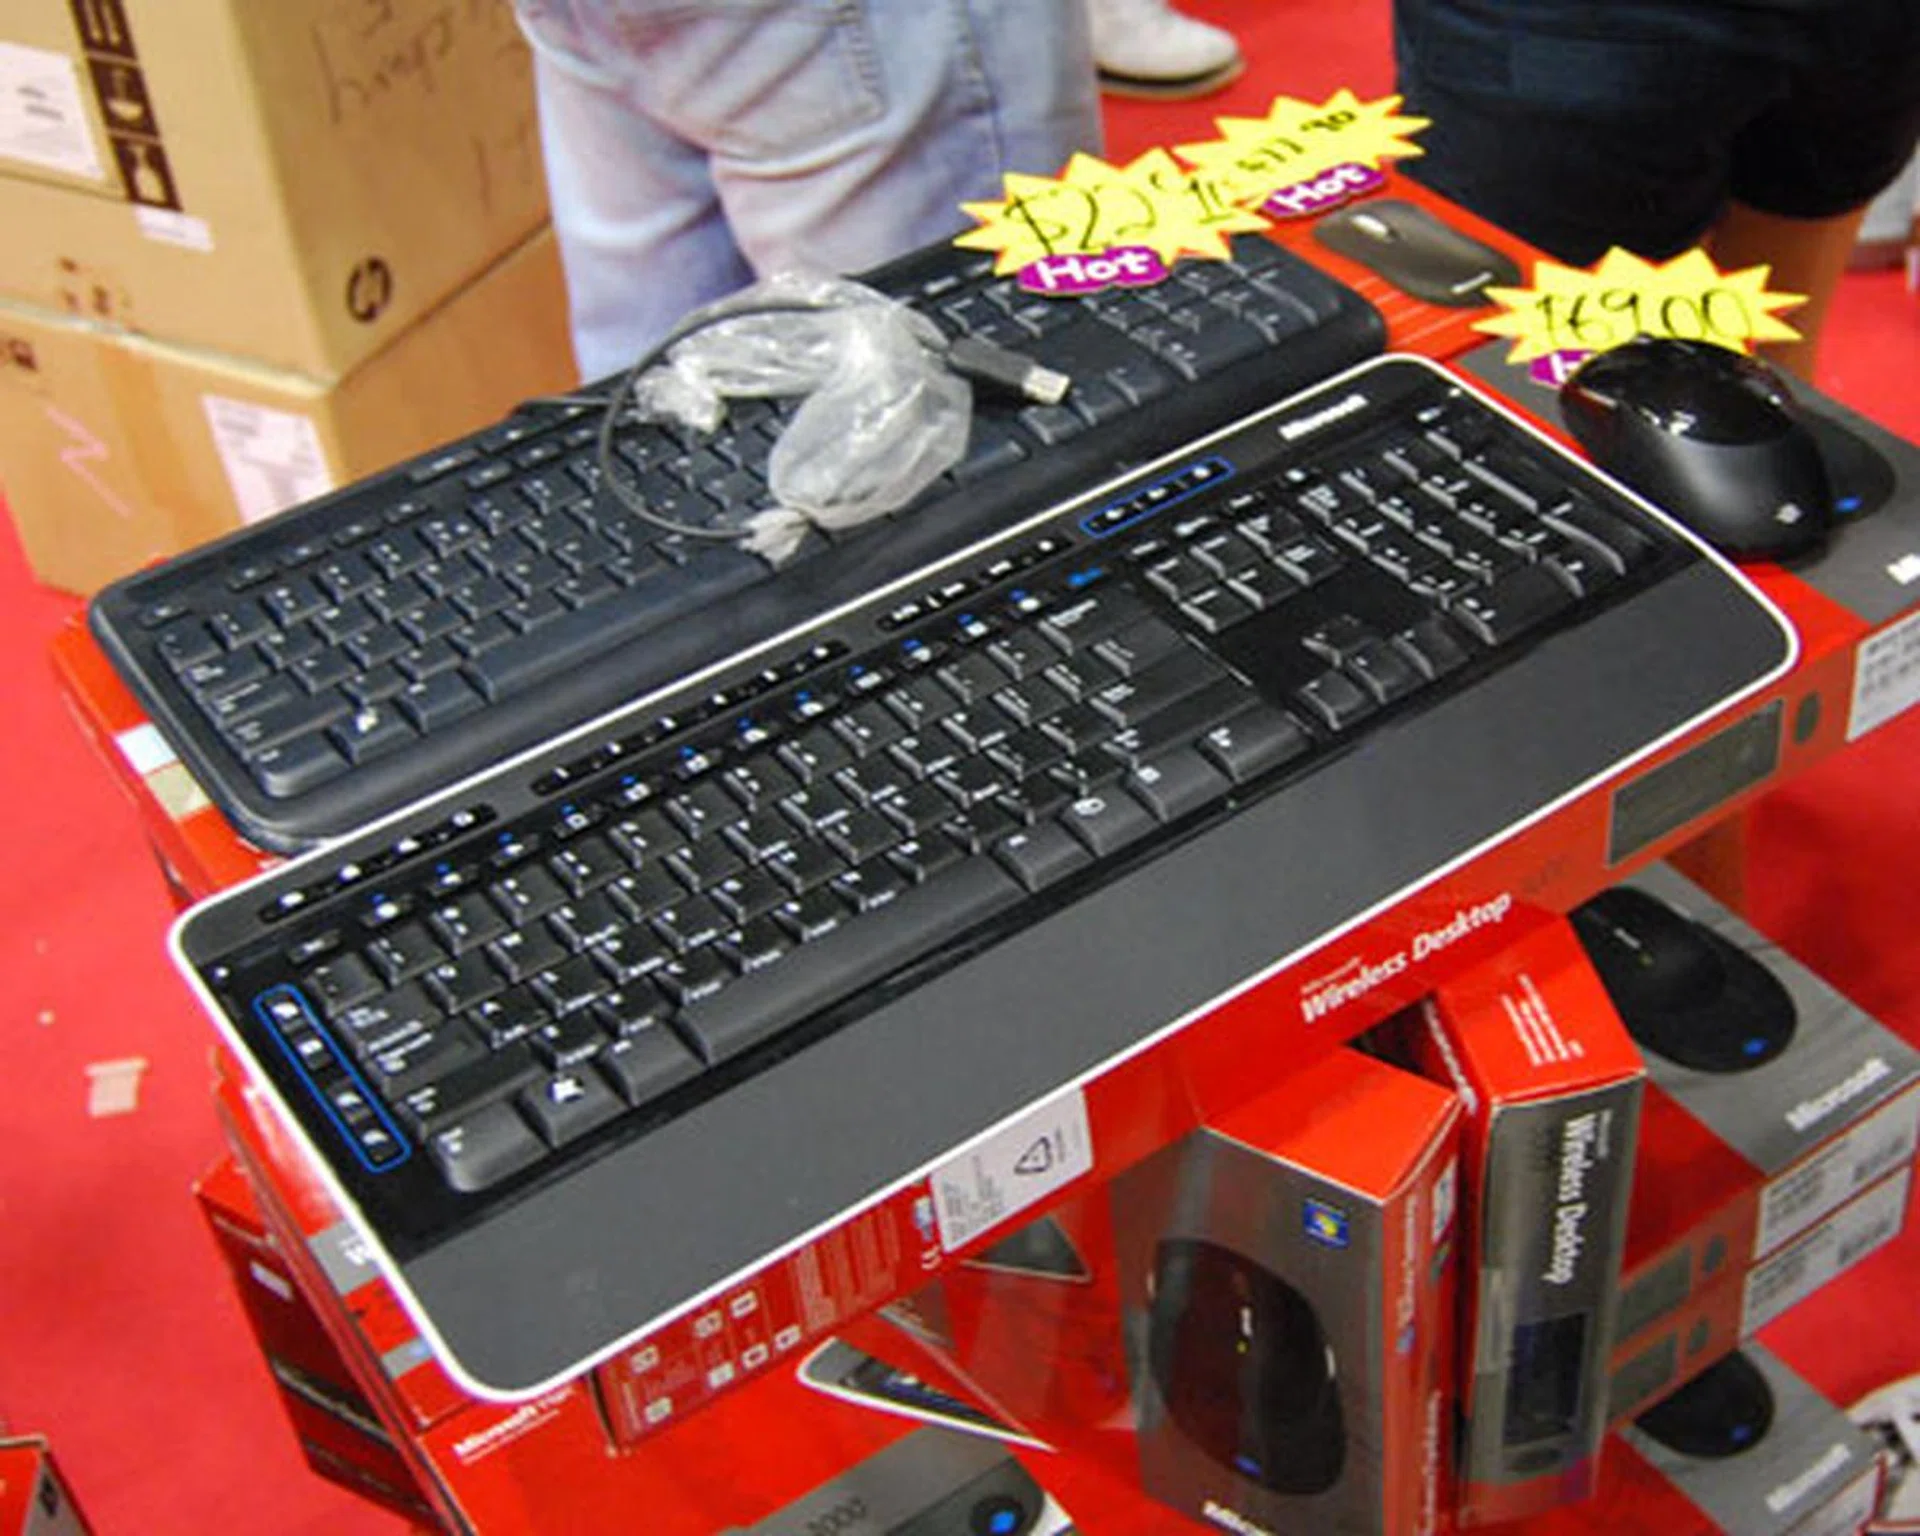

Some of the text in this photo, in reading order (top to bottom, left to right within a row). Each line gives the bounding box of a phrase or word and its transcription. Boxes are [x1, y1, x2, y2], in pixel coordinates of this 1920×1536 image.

[1271, 165, 1368, 212] Hot
[1037, 249, 1151, 289] Hot
[1300, 893, 1512, 1025] Wireless Desktop
[1541, 1112, 1597, 1284] Wireless Desktop
